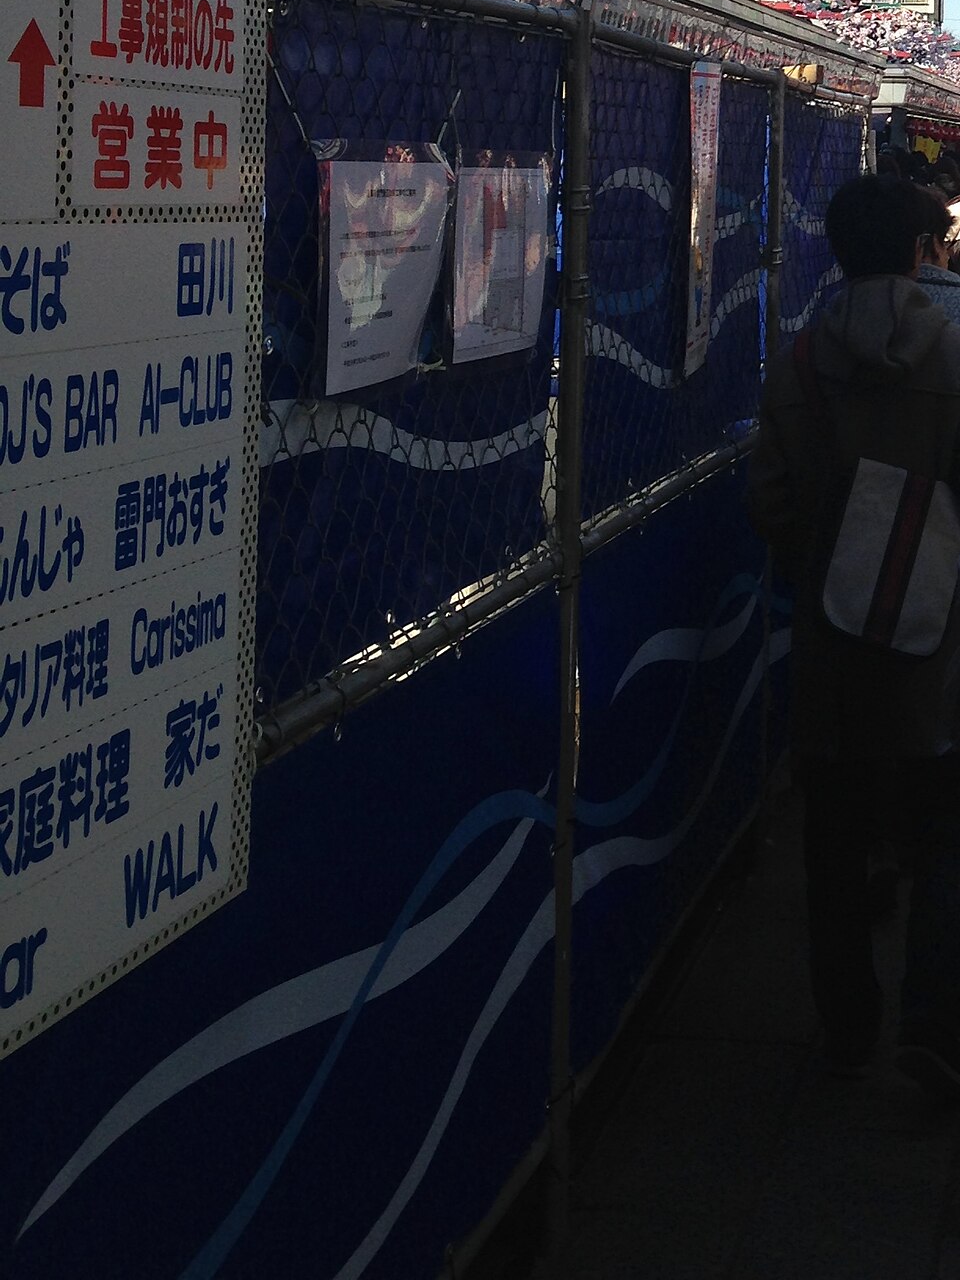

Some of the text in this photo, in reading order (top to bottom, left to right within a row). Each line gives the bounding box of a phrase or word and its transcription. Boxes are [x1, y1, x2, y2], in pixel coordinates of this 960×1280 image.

[91, 100, 228, 190] 営業中
[0, 237, 234, 334] そば 田川
[64, 369, 119, 453] BAR
[139, 352, 233, 437] AI-CLUB
[115, 455, 230, 571] 雷門おすぎ
[131, 591, 226, 675] Carissima
[164, 683, 223, 789] 家だ
[124, 801, 218, 928] WALK
